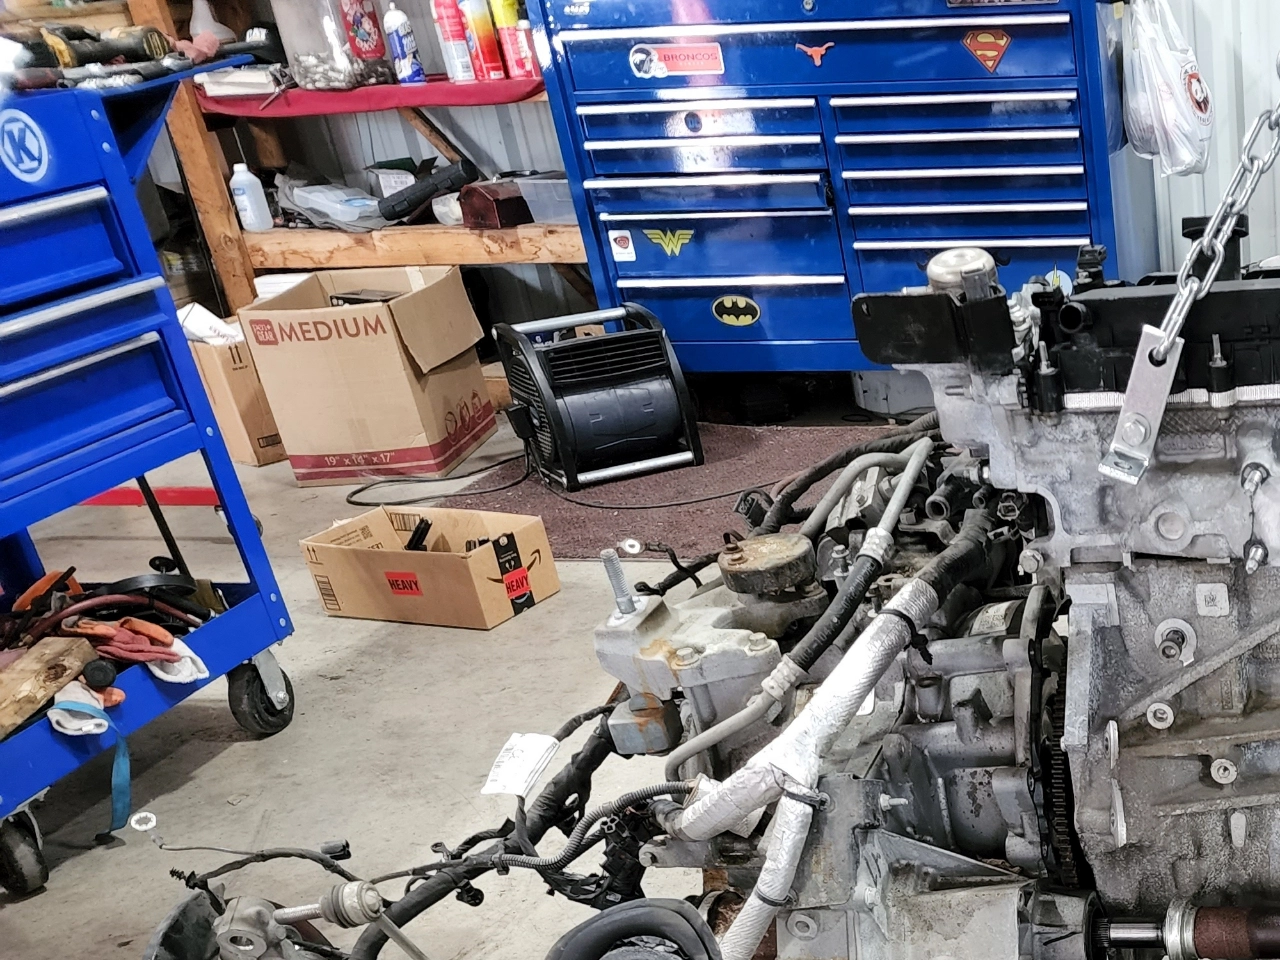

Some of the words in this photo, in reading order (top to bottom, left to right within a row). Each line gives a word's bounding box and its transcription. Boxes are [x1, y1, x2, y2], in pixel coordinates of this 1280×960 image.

[663, 52, 719, 62] BRONCOS
[277, 314, 387, 342] MEDIUM
[256, 330, 275, 341] GEAR
[324, 455, 340, 466] 19"
[380, 452, 395, 463] 17"
[388, 578, 420, 592] HEAVY
[505, 574, 530, 594] HEAVY
